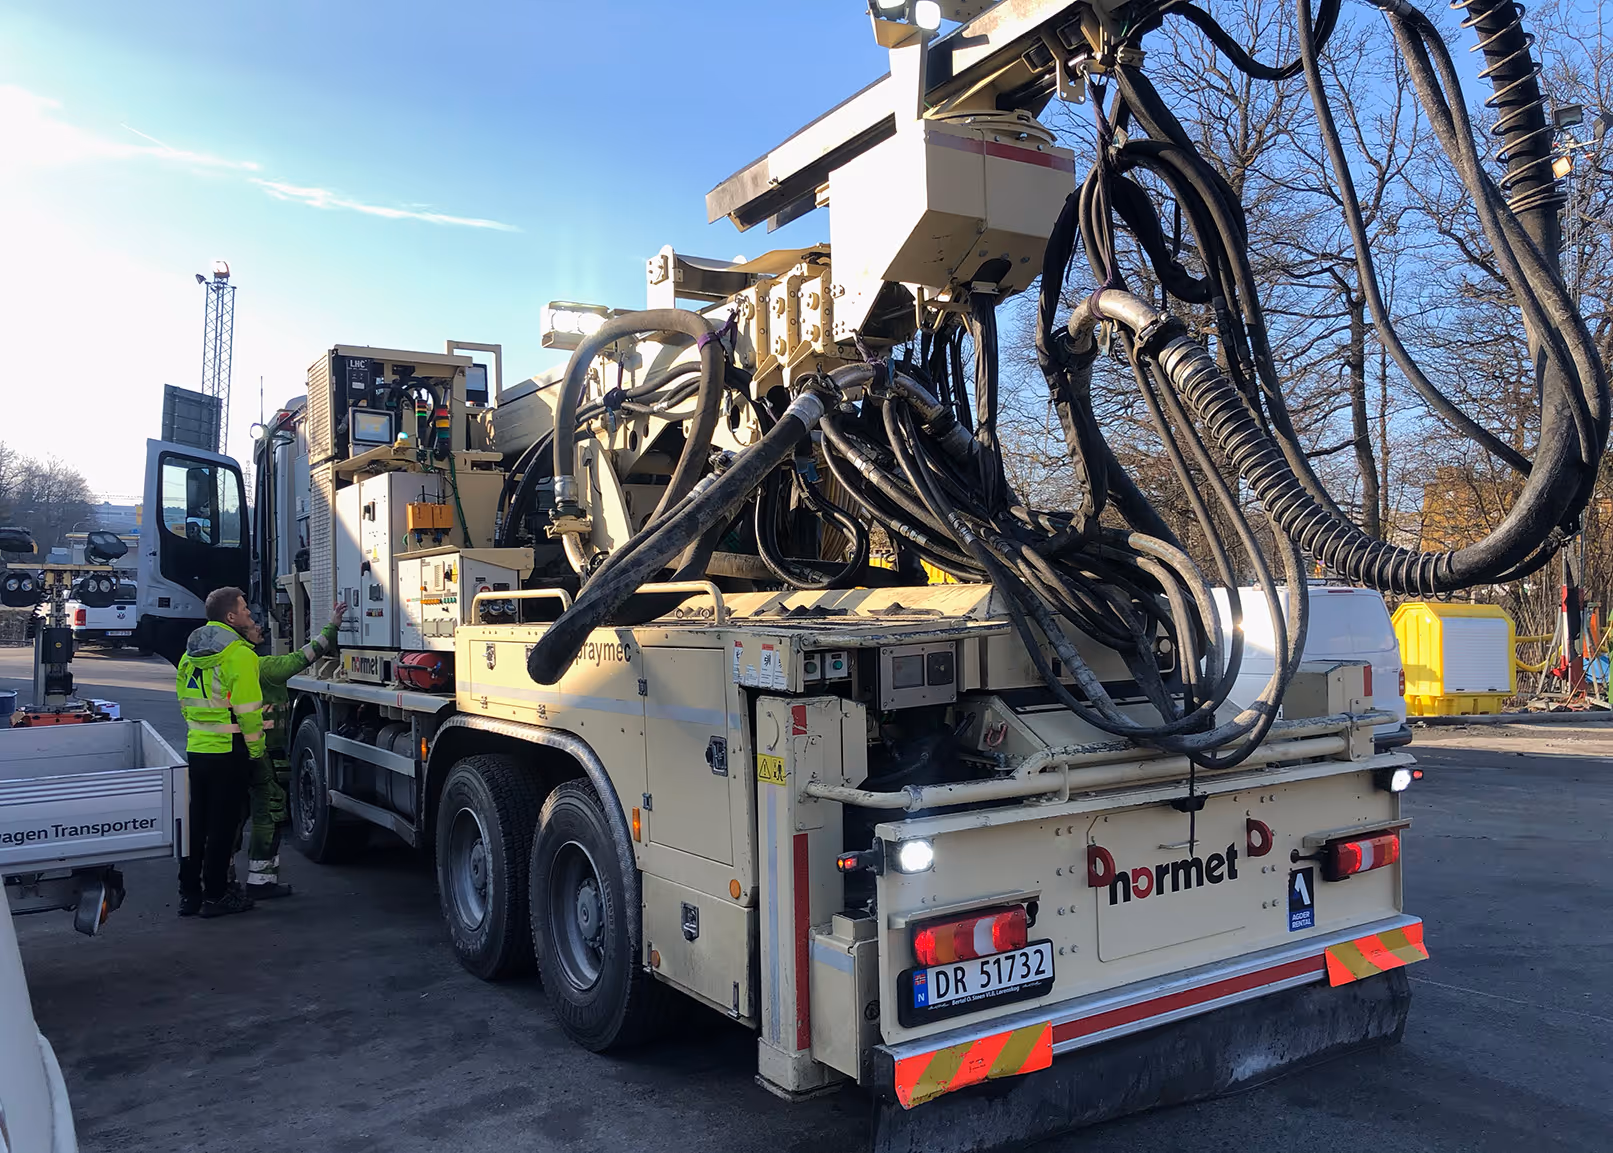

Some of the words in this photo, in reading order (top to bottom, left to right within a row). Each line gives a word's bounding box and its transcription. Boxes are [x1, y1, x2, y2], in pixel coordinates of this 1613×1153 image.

[351, 655, 378, 675] normet
[0, 829, 48, 846] agen
[51, 817, 157, 838] Transporter
[1109, 842, 1238, 905] normet
[1292, 911, 1310, 921] AGDER
[1292, 919, 1311, 928] RENTAL
[917, 992, 925, 1002] N
[935, 966, 968, 999] DR
[980, 949, 1046, 988] 51732
